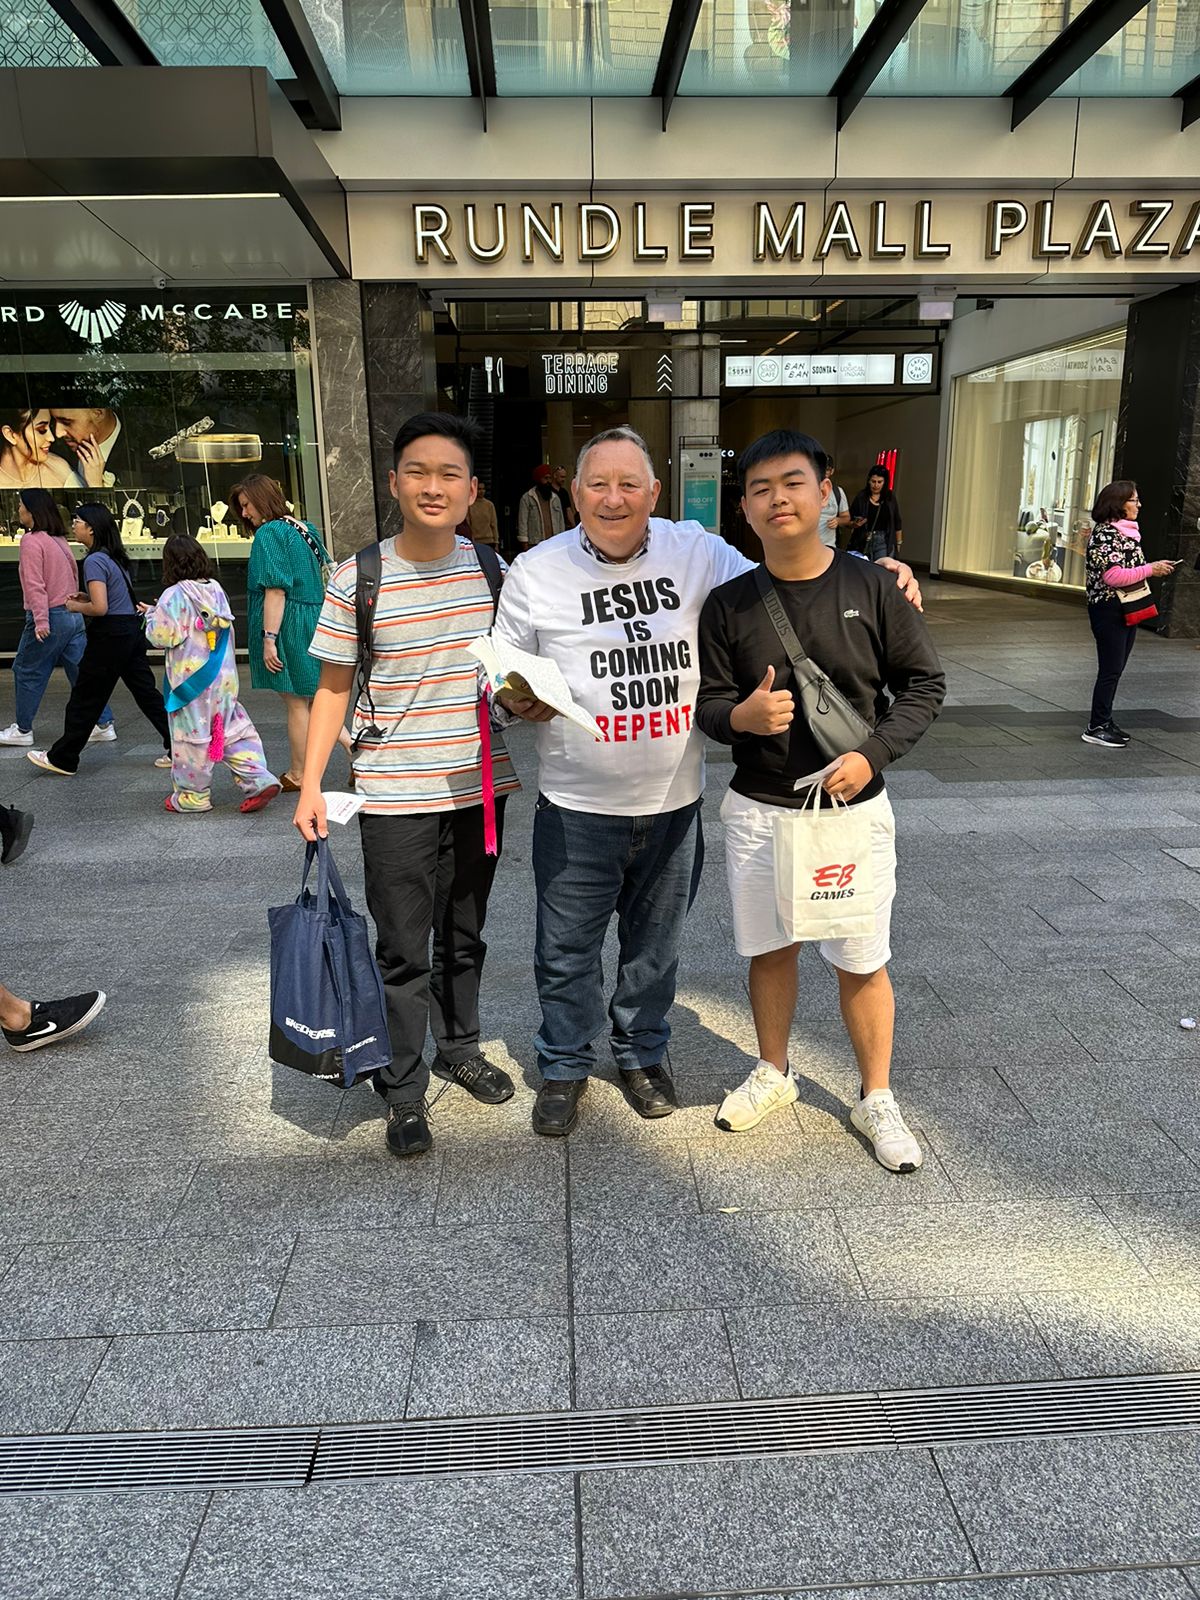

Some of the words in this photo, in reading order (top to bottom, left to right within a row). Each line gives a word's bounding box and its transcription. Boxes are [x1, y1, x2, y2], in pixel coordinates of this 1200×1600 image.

[412, 202, 715, 264] RUNDLE
[753, 201, 951, 262] MALL
[0, 306, 45, 323] RD
[541, 352, 620, 374] TERRACE
[784, 362, 805, 370] BAN
[788, 370, 809, 379] BAN
[812, 366, 832, 375] SOONTA
[545, 374, 608, 394] DINING
[580, 577, 681, 625] JESUS
[624, 620, 652, 643] IS
[590, 640, 692, 679] COMING
[611, 676, 679, 711] SOON
[594, 704, 692, 743] REPENT
[812, 863, 857, 889] EB
[810, 888, 855, 901] GAMES
[285, 1016, 336, 1040] SKECHERS
